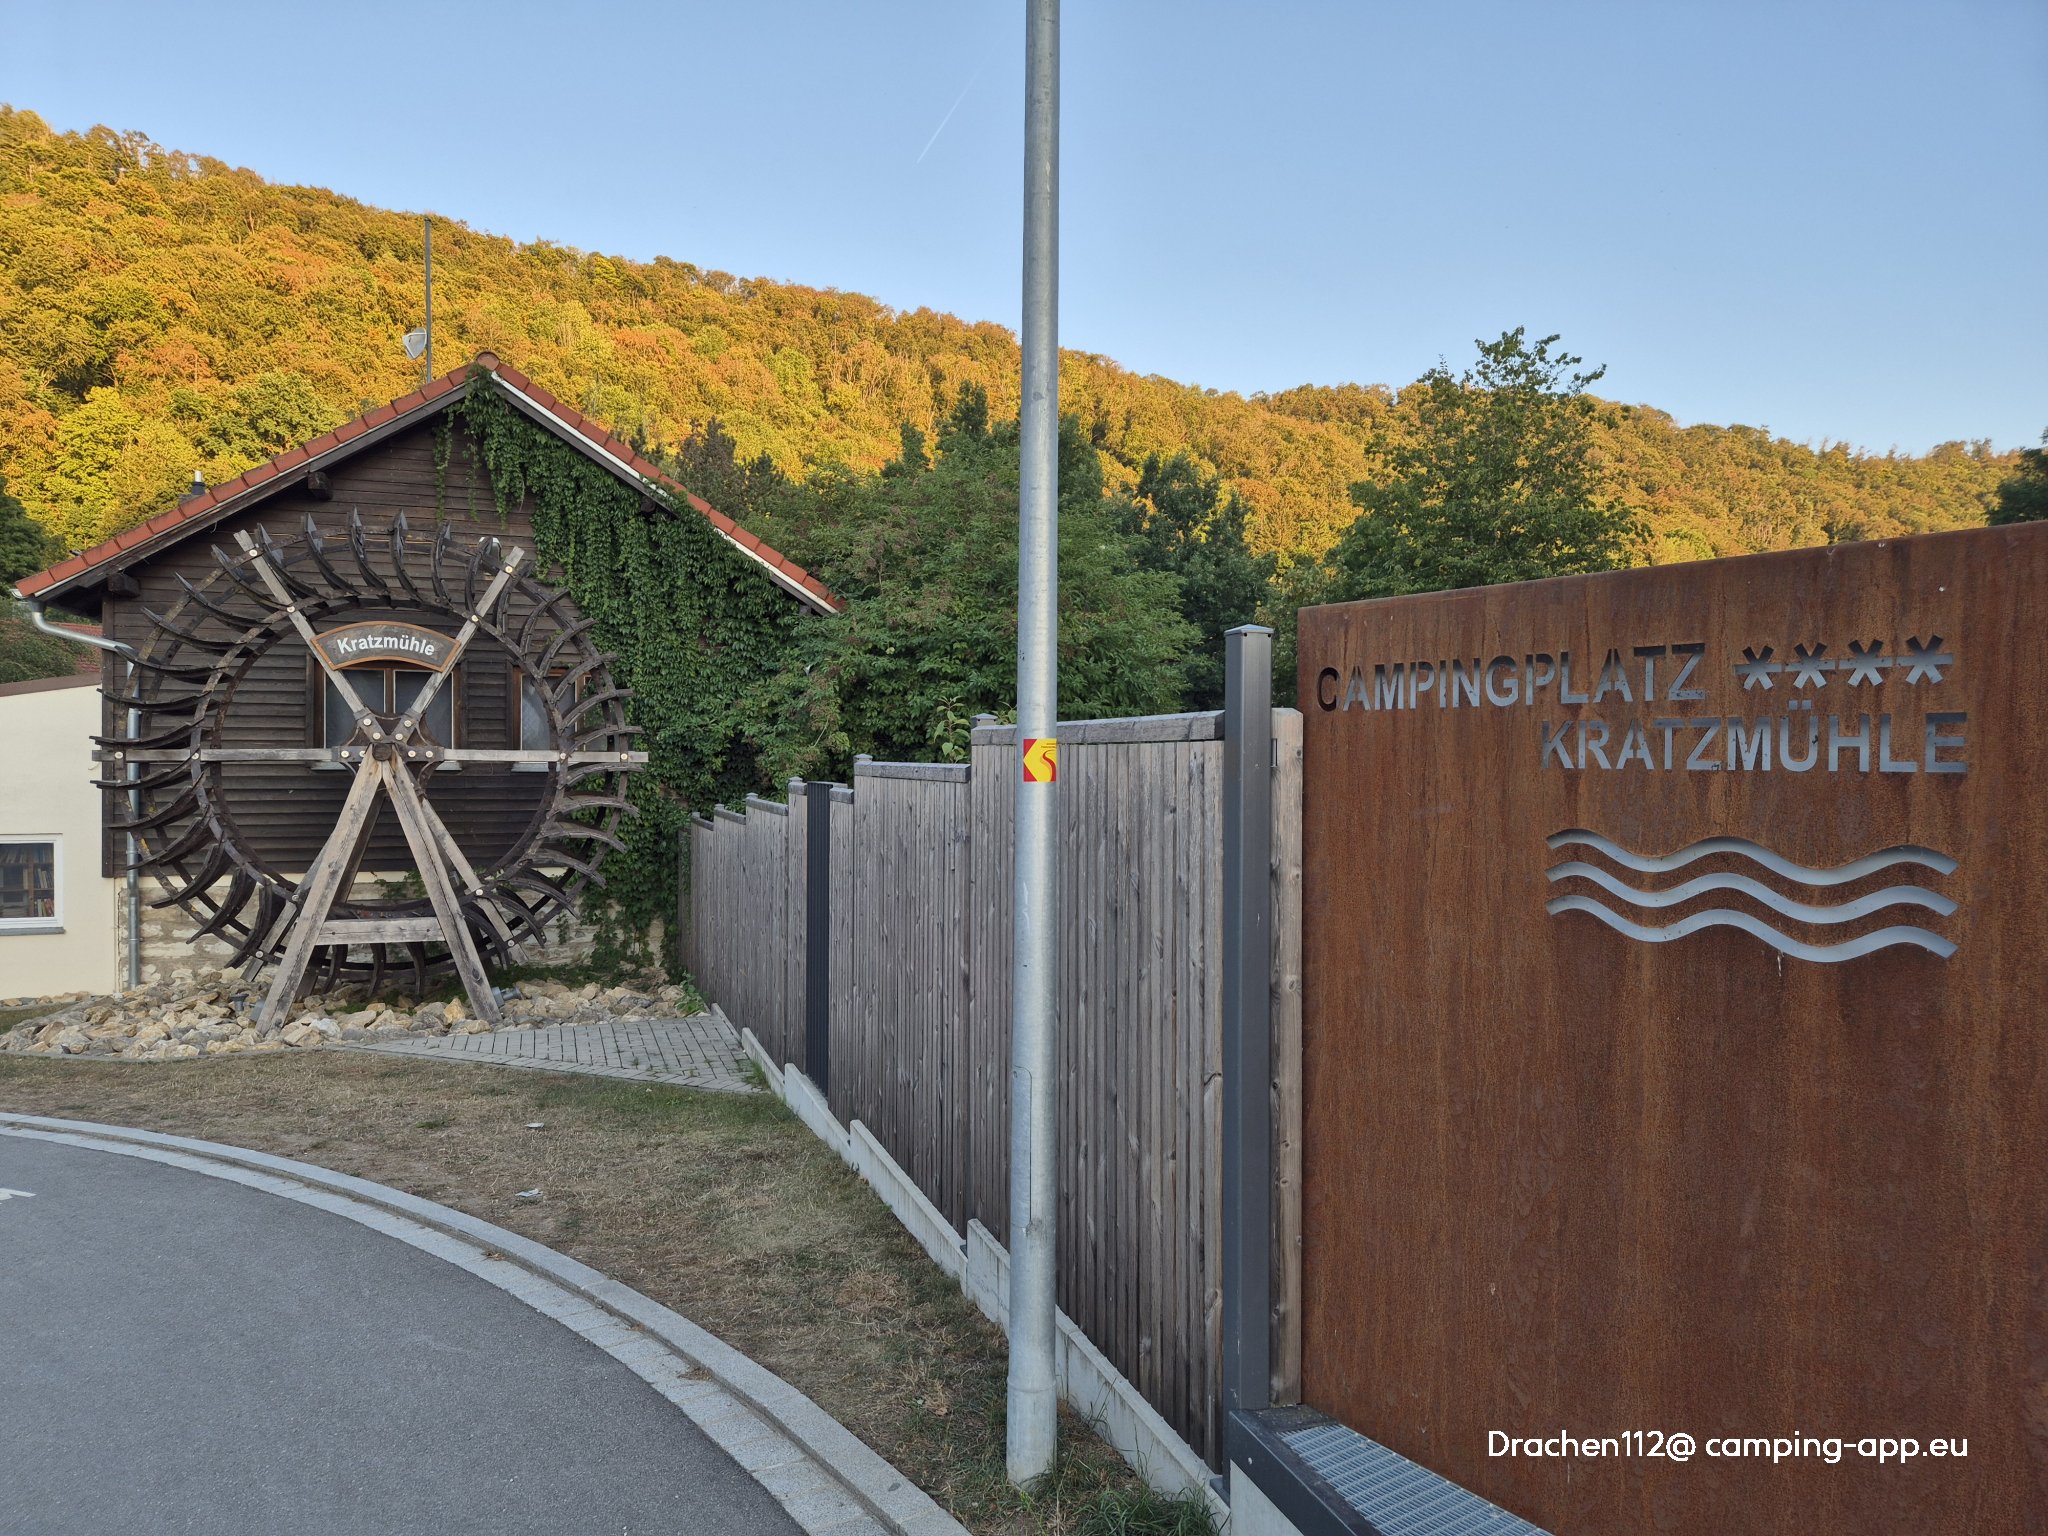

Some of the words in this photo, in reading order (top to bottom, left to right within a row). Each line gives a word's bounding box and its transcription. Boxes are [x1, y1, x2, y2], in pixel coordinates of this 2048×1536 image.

[337, 634, 435, 656] Kratzmühle
[1317, 642, 1707, 712] CAMPINGPLATZ
[1541, 699, 1968, 774] KRATZMÜHLE
